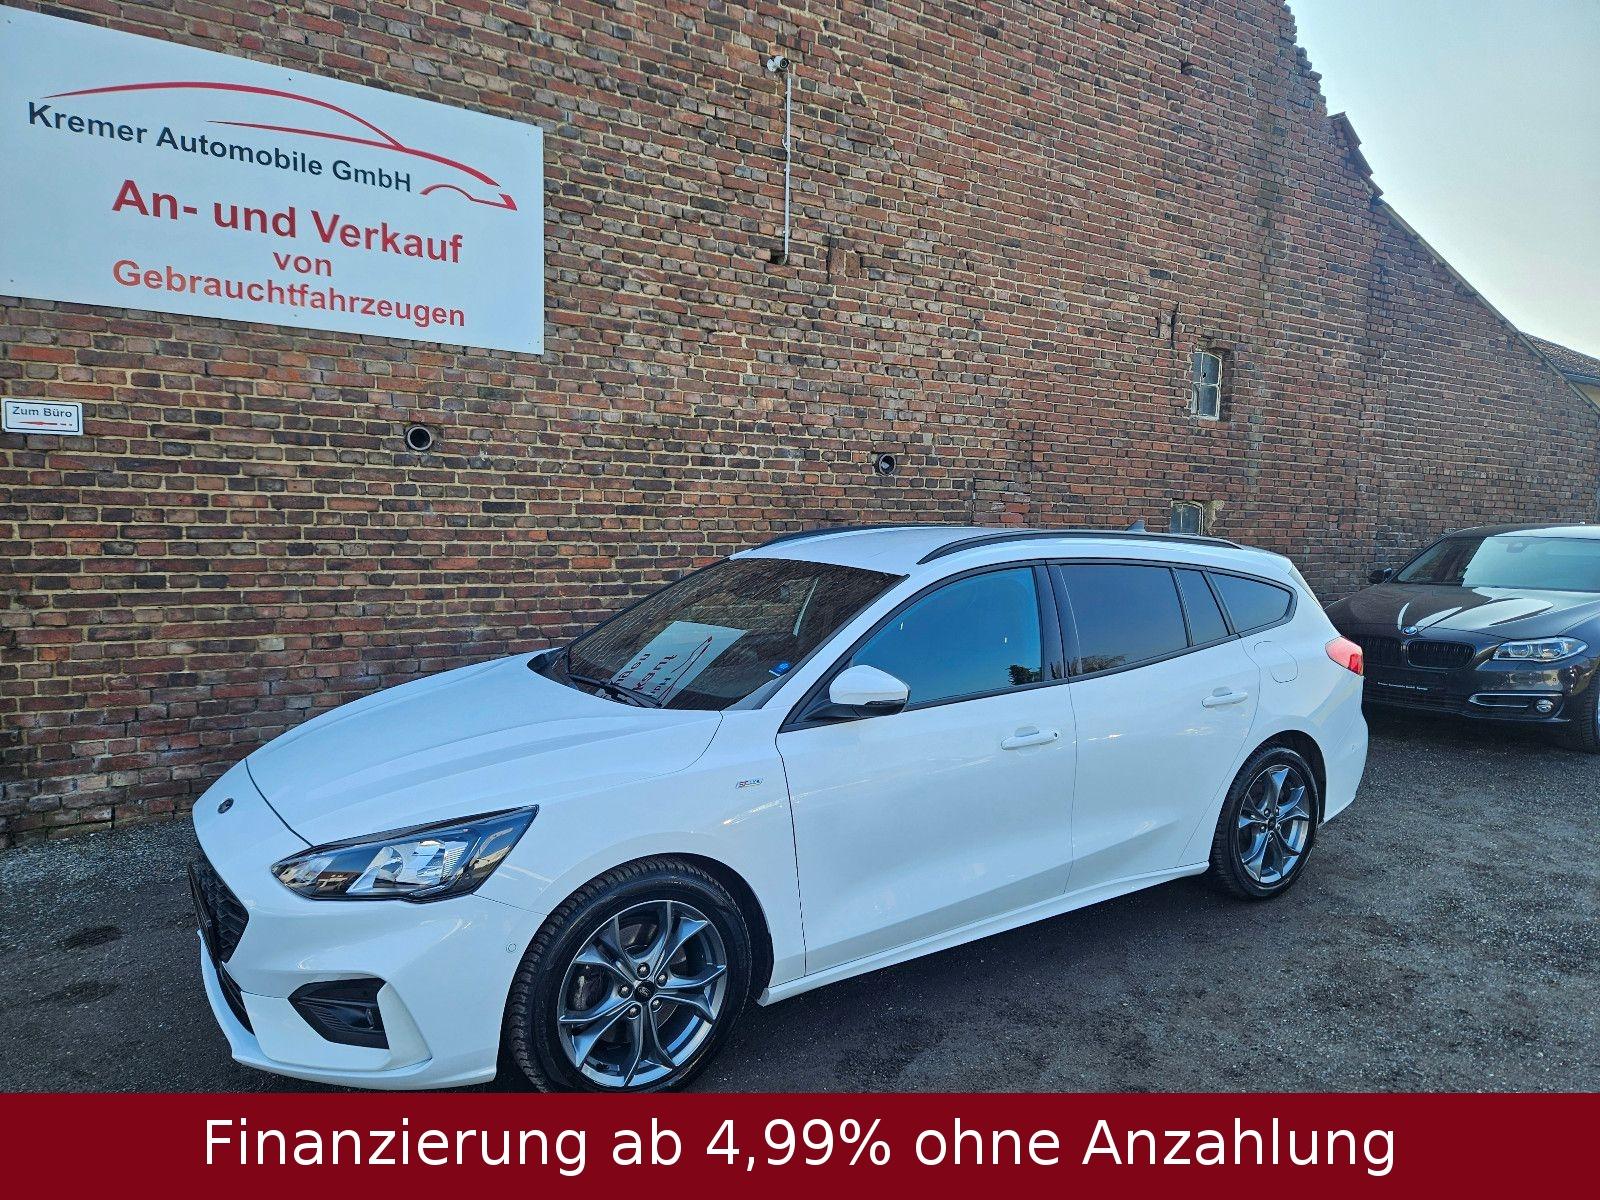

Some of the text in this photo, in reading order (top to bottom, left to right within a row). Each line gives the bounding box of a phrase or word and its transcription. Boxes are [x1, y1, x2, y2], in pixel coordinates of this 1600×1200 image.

[28, 101, 411, 192] Kremer Automobile GmbH
[111, 179, 463, 263] An- und Verkauf
[112, 259, 465, 328] Gebrauchtfahrzeugen
[273, 252, 332, 277] von
[12, 406, 72, 418] Zum Büro
